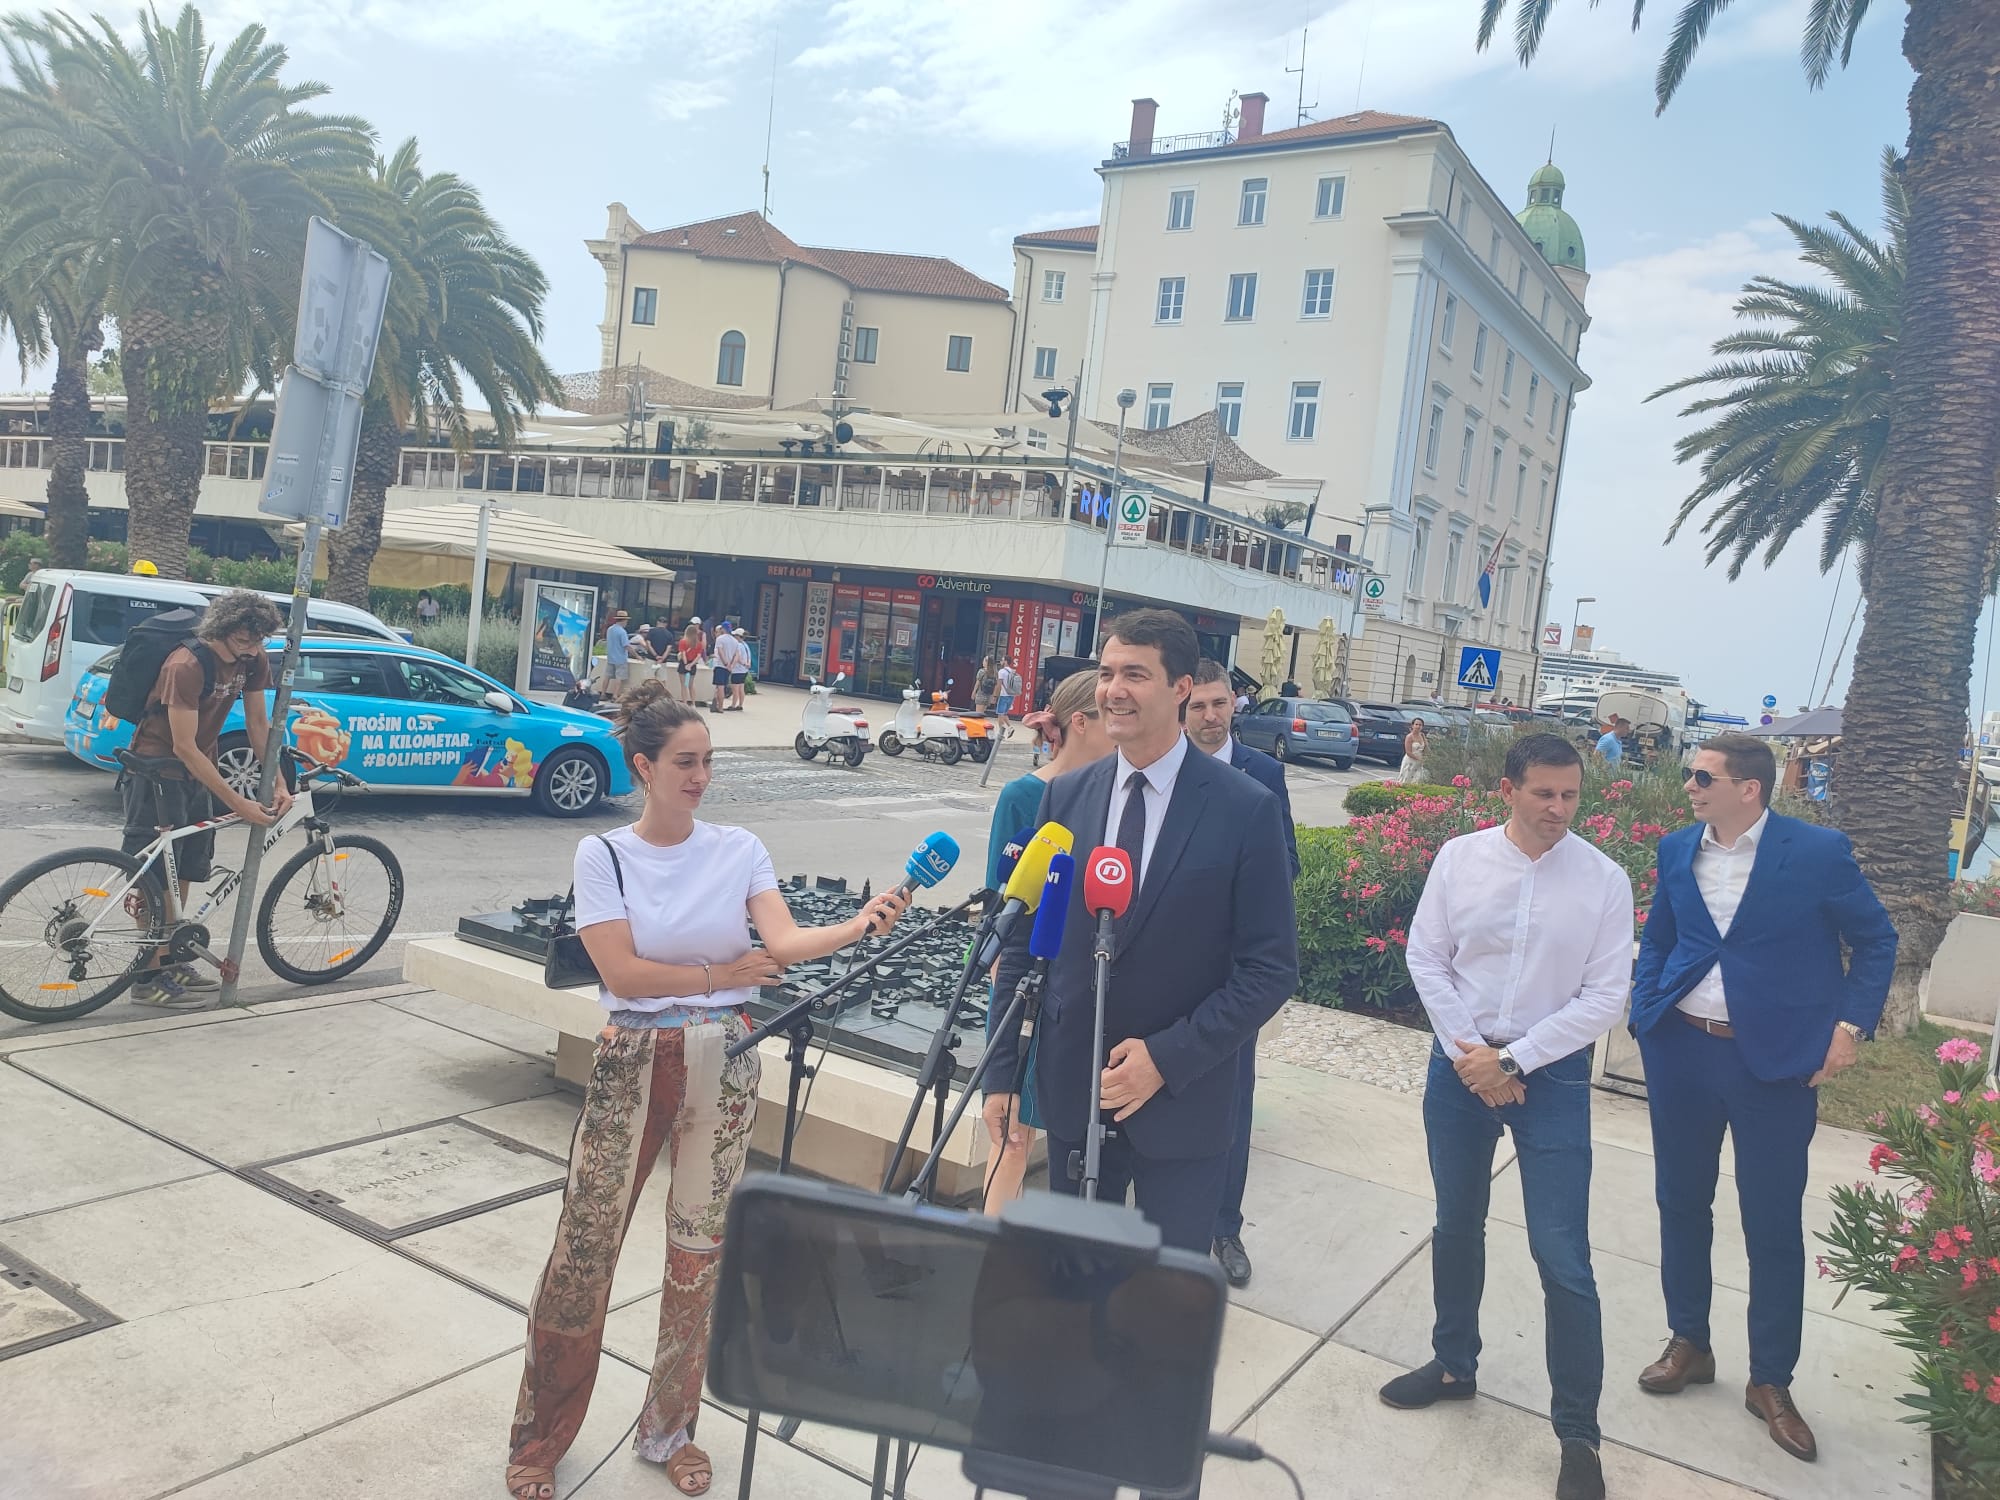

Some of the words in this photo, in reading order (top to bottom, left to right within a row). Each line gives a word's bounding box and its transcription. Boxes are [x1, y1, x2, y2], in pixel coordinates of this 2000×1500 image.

[1118, 523, 1145, 531] SPAR
[768, 565, 789, 576] RENT
[789, 567, 795, 576] A
[796, 567, 812, 577] CAR
[917, 576, 935, 589] GO
[936, 576, 991, 593] Adventure
[129, 599, 158, 609] TAXI
[1071, 591, 1084, 605] GO
[1023, 605, 1040, 712] EXCURSIONS
[348, 712, 402, 732] TROŠIN
[362, 734, 384, 750] NA
[389, 733, 473, 750] KILOMETAR.
[362, 750, 461, 768] #BOLIMEPIPI
[928, 848, 951, 873] TVD
